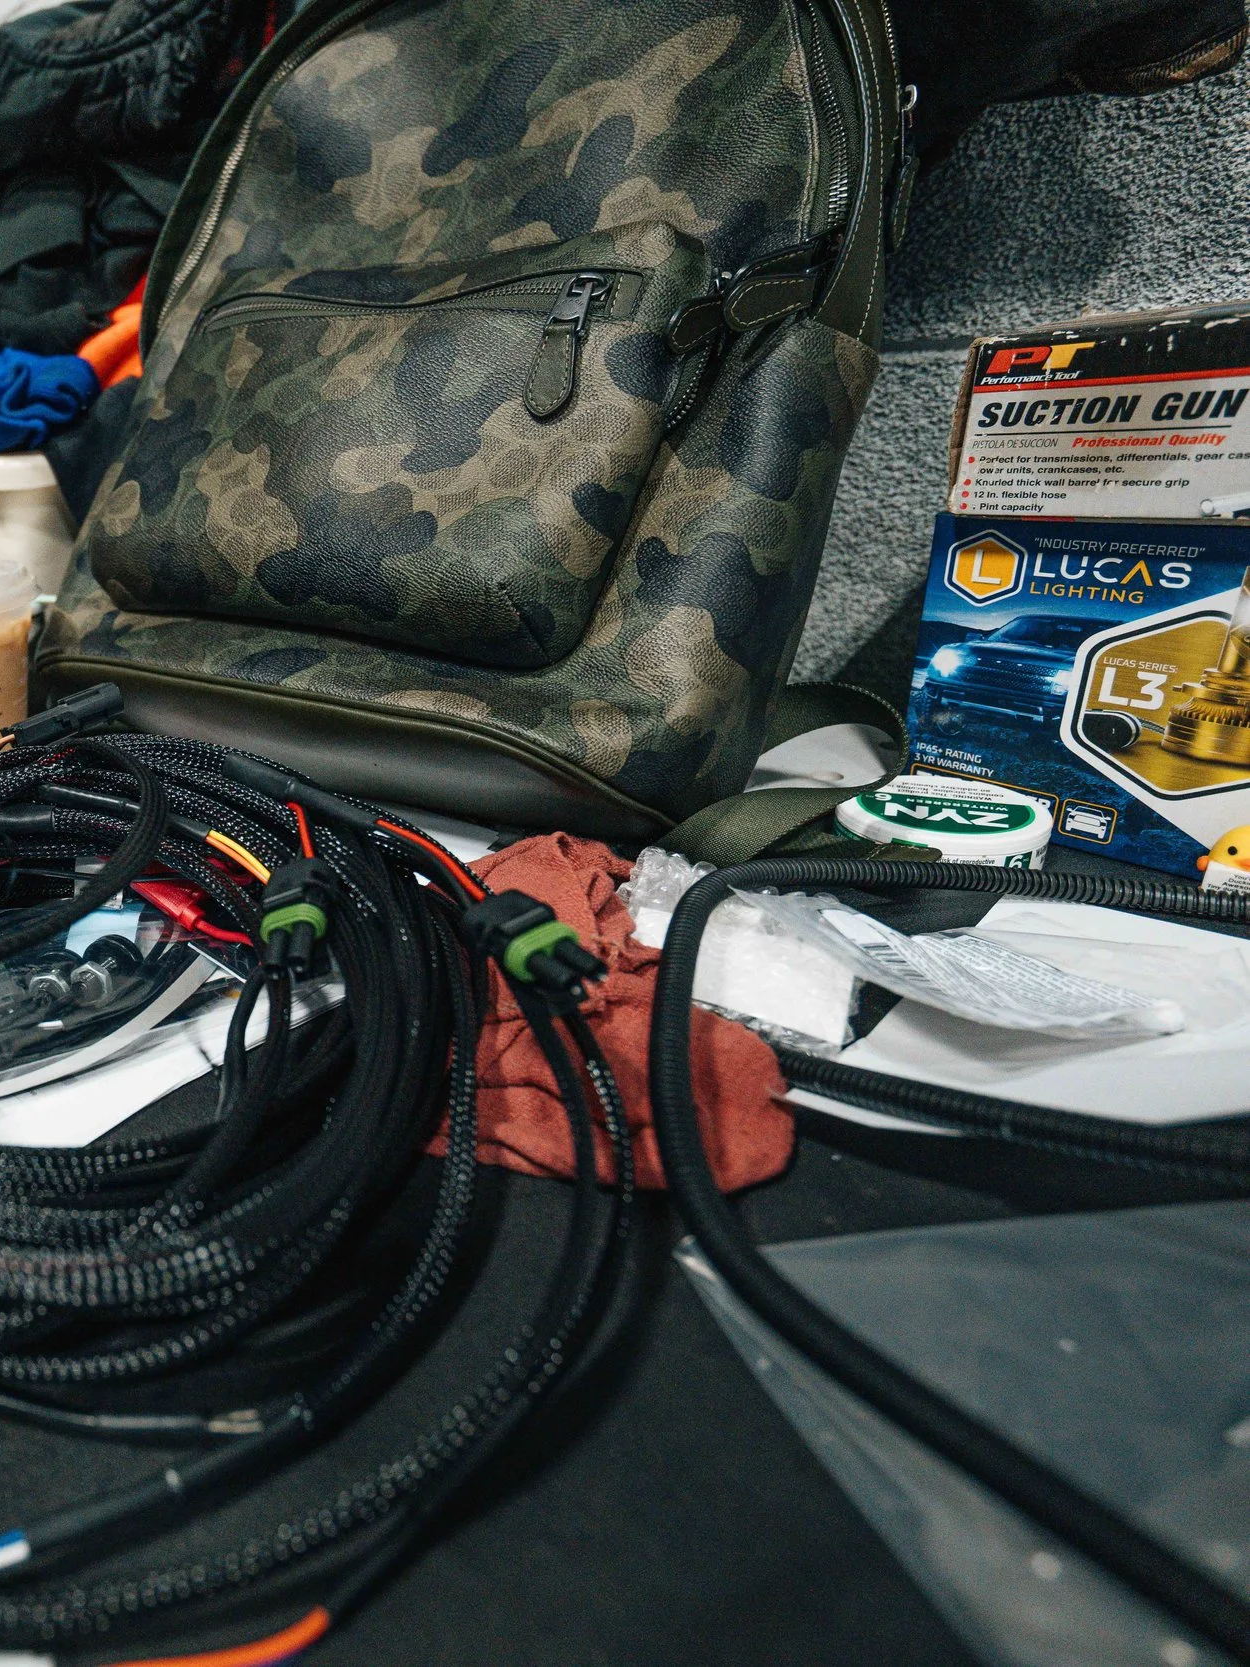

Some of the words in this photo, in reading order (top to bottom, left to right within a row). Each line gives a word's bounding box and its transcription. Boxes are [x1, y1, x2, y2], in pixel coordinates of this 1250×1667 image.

[986, 341, 1096, 374] PT
[980, 374, 1052, 385] Performance
[1053, 370, 1080, 381] Tool
[977, 395, 1142, 428] SUCTION
[1151, 388, 1250, 422] GUN
[972, 439, 1004, 449] PISTOLA
[1018, 438, 1058, 448] SUCCION
[1072, 434, 1166, 448] Professional
[1168, 433, 1227, 446] Quality
[1016, 455, 1032, 464] for
[1033, 454, 1113, 464] transmissions,
[1116, 452, 1191, 461] differentials,
[1195, 453, 1224, 463] gear
[977, 466, 1004, 475] ower
[1006, 466, 1035, 475] units,
[1037, 465, 1101, 475] crankcases,
[1104, 465, 1125, 474] etc.
[975, 478, 1014, 487] Knurled
[1016, 478, 1041, 487] thick
[1044, 478, 1065, 487] wall
[1121, 479, 1162, 487] secure
[1164, 478, 1190, 488] grip
[973, 491, 984, 499] 12
[1001, 490, 1038, 499] flexible
[1040, 491, 1067, 499] hose
[979, 502, 999, 511] Pint
[1001, 503, 1044, 512] capacity
[971, 549, 1002, 585] L
[1033, 552, 1192, 589] LUCAS
[1030, 581, 1144, 604] LIGHTING
[1103, 656, 1137, 668] LUCAS
[1138, 661, 1178, 674] SERIES:
[1097, 666, 1168, 710] L3
[916, 742, 943, 754] IP65+
[945, 748, 982, 764] RATING
[914, 752, 920, 761] 3
[922, 754, 935, 764] YR
[936, 757, 995, 778] WARRANTY
[874, 793, 892, 801] 6
[906, 798, 1008, 811] WINTERGREEN
[884, 802, 1009, 828] ZYN
